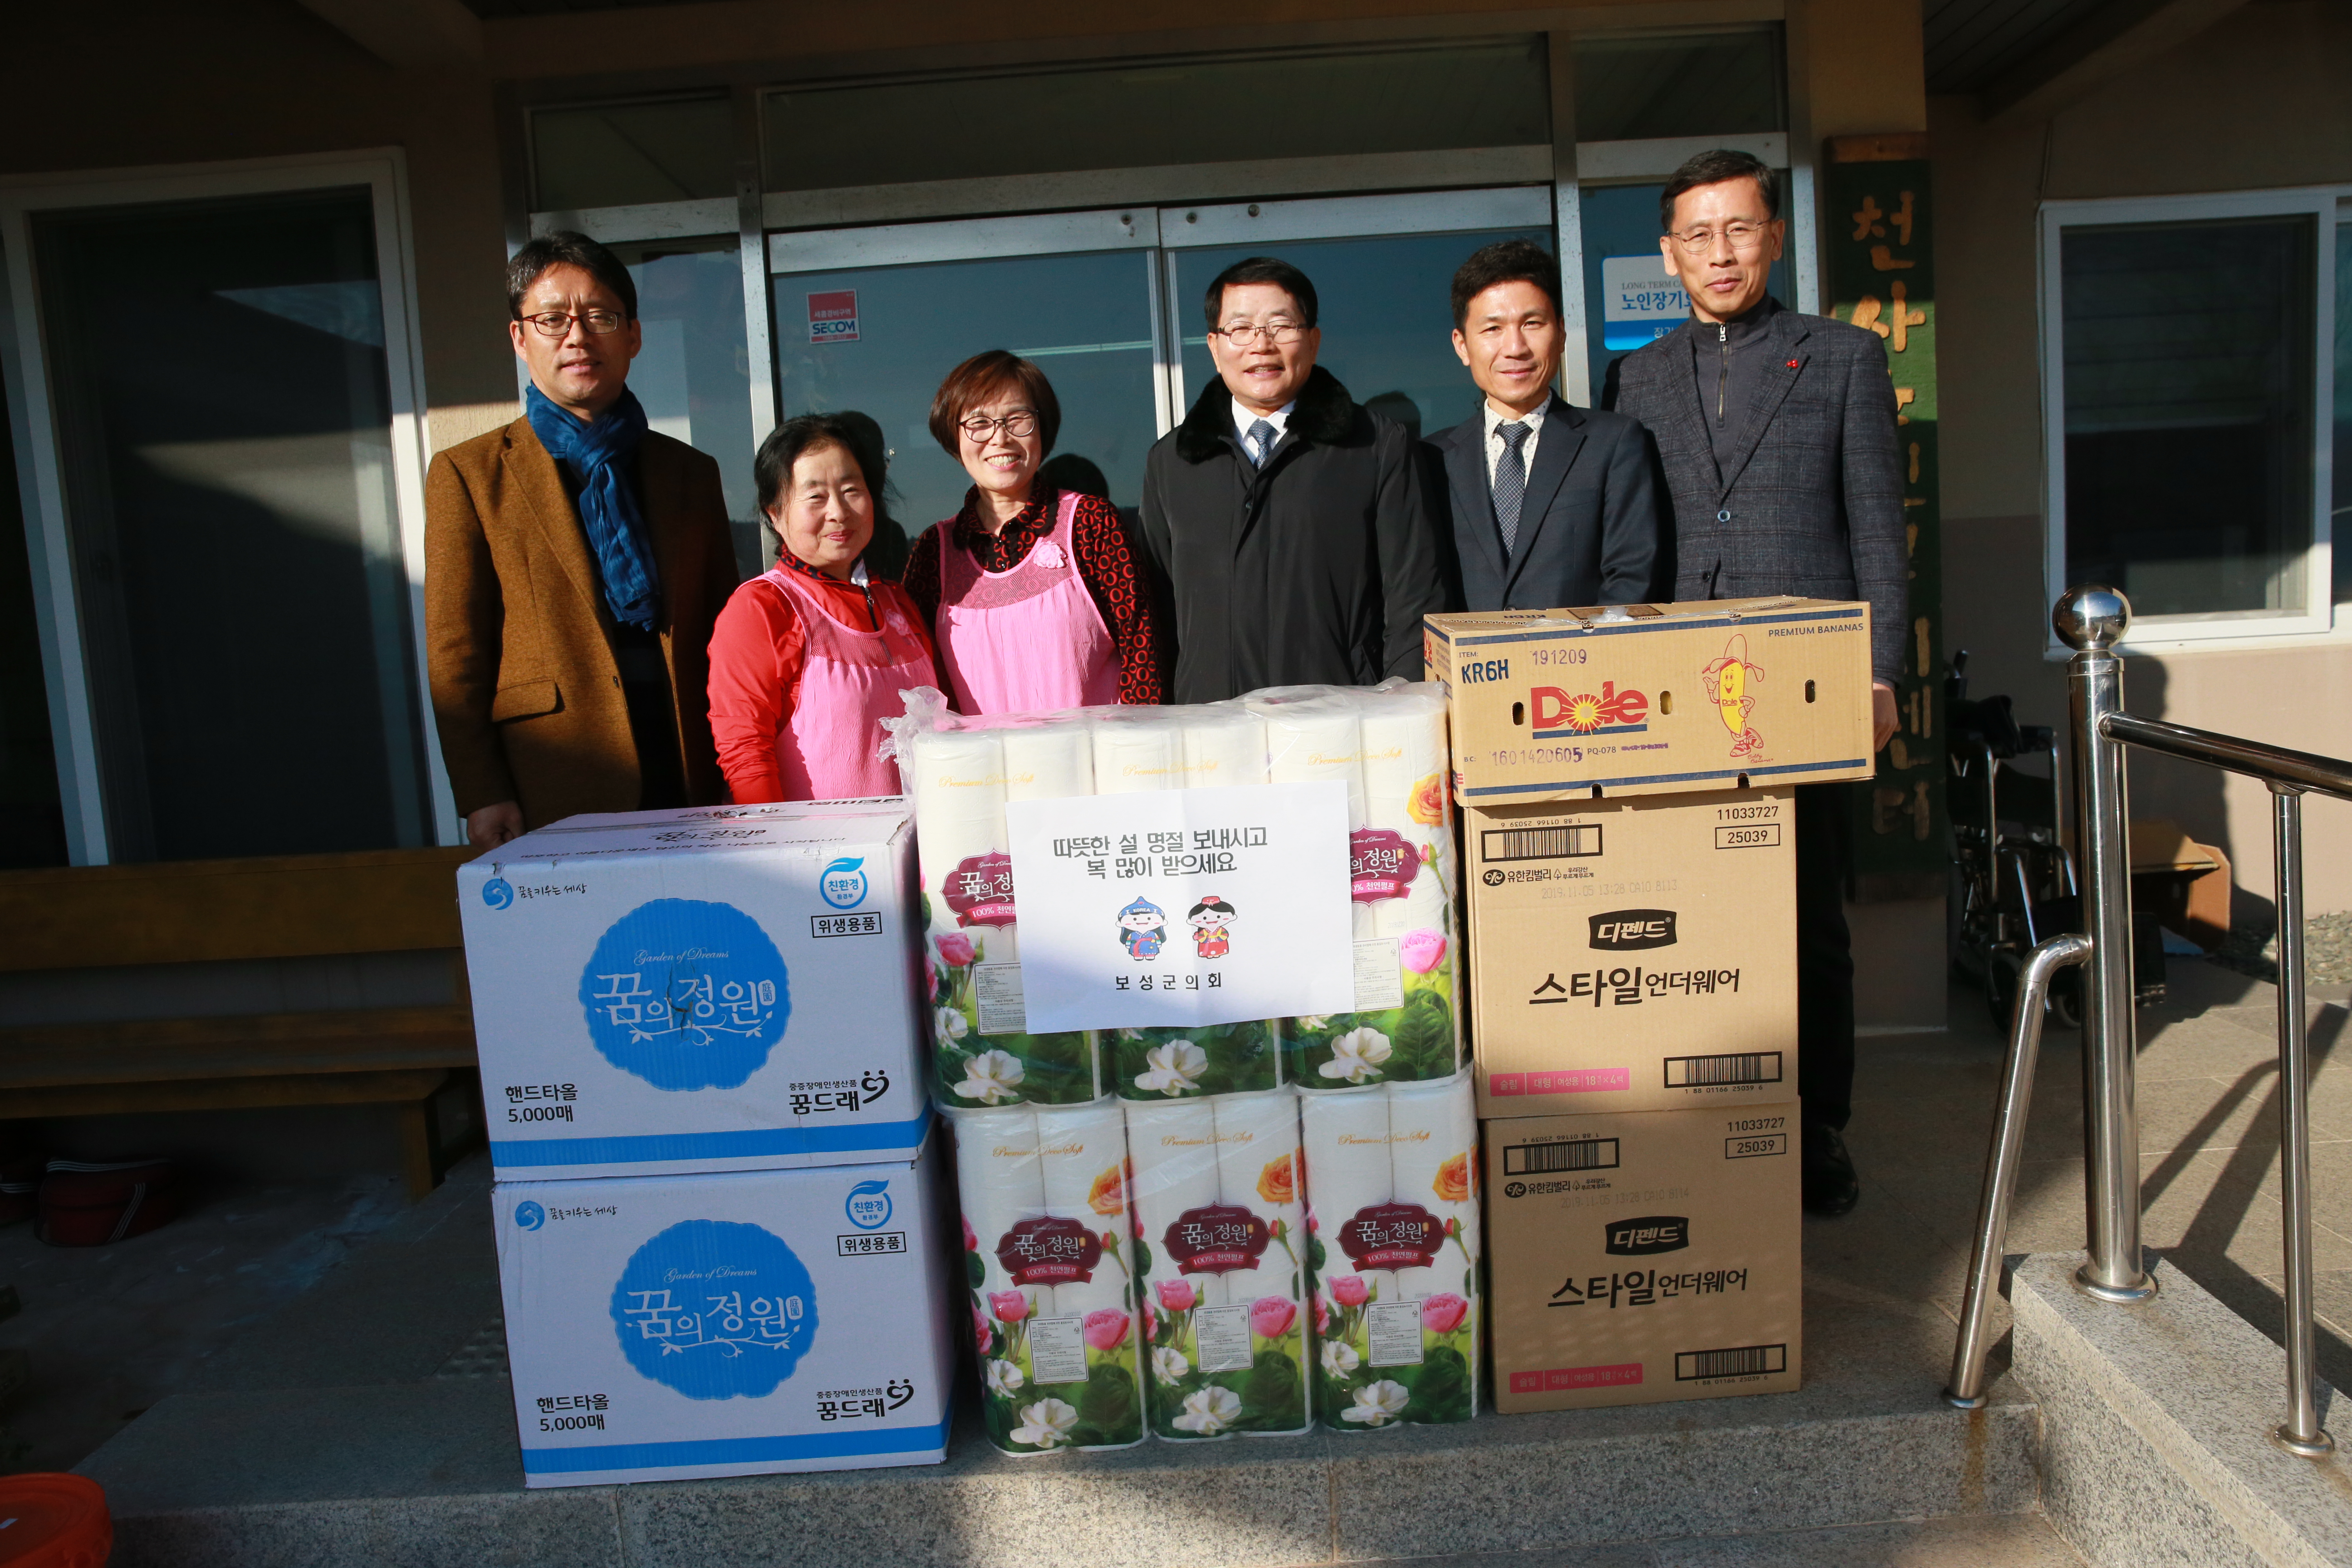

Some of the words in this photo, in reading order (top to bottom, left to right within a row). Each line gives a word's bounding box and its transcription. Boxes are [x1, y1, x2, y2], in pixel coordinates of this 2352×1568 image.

[1622, 282, 1646, 290] LONG
[813, 320, 855, 335] SECOM
[1769, 626, 1815, 637] PREMIUM
[1818, 623, 1863, 634] BANANAS
[1532, 649, 1587, 666] 191209
[1461, 658, 1509, 684] KR6H
[1530, 681, 1649, 732] Dole
[1307, 753, 1352, 766] Premium
[1381, 747, 1402, 762] Soft
[1587, 745, 1617, 755] PQ-078
[1122, 764, 1167, 776] Premium
[1197, 760, 1219, 773] Soft
[938, 776, 983, 788] Premium
[1012, 772, 1034, 787] Soft
[1717, 806, 1779, 821] 11033727
[1053, 836, 1110, 858] 따뜻한
[1118, 833, 1137, 855] 설
[1147, 832, 1184, 853] 명절
[1193, 827, 1268, 850] 보내시고
[1727, 830, 1769, 844] 25039
[1087, 859, 1106, 879] 복
[1115, 857, 1152, 878] 많이
[1161, 852, 1237, 877] 받으세요
[1363, 848, 1397, 868] 정원
[1507, 868, 1552, 883] 유한킴벌리
[828, 878, 859, 892] 친환경
[959, 872, 993, 896] 꿈의
[1366, 882, 1395, 890] 천연펄프
[1542, 885, 1593, 899] 2019.11.05
[1599, 883, 1625, 895] 13:28
[1656, 879, 1677, 891] 8113
[972, 906, 995, 918] 100%
[818, 916, 876, 933] 위생용품
[1598, 920, 1667, 943] 디펜드
[634, 949, 674, 965] Garden
[676, 950, 685, 963] of
[687, 947, 729, 960] Dreams
[593, 972, 674, 1029] 꿈의
[677, 974, 761, 1024] 정원
[789, 1078, 858, 1091] 중증장애인생산품
[1499, 1079, 1517, 1090] 슬림
[1534, 1078, 1551, 1088] 대형
[1558, 1077, 1579, 1086] 여성용
[505, 1083, 578, 1105] 핸드타올
[789, 1092, 860, 1115] 꿈드래
[508, 1107, 574, 1123] 5,000매
[1727, 1117, 1785, 1132] 11033727
[1161, 1135, 1205, 1146] Premium
[1206, 1132, 1231, 1144] Deco
[1233, 1131, 1254, 1145] Soft
[1338, 1134, 1382, 1145] Premium
[1383, 1132, 1408, 1143] Deco
[1409, 1130, 1431, 1144] Soft
[993, 1146, 1035, 1156] Premium
[1037, 1144, 1062, 1156] Deco
[1063, 1142, 1083, 1156] Soft
[1737, 1140, 1775, 1154] 25039
[1528, 1181, 1570, 1194] 유한킴벌리
[1615, 1192, 1639, 1204] 13:28
[1669, 1188, 1689, 1199] 8114
[853, 1199, 884, 1214] 친환경
[1181, 1223, 1213, 1245] 꿈의
[1215, 1223, 1247, 1241] 정원
[1356, 1221, 1388, 1242] 꿈의
[1390, 1220, 1422, 1240] 정원
[1614, 1227, 1680, 1248] 디펜드
[844, 1235, 901, 1252] 위생용품
[1014, 1234, 1045, 1256] 꿈의
[1047, 1235, 1079, 1254] 정원
[1193, 1255, 1215, 1265] 100%
[1367, 1252, 1389, 1262] 100%
[1392, 1251, 1419, 1259] 천연펄프
[664, 1267, 703, 1283] Garden
[705, 1269, 713, 1282] of
[715, 1265, 757, 1279] Dreams
[1026, 1267, 1047, 1277] 100%
[1049, 1265, 1077, 1274] 천연펄프
[623, 1289, 703, 1343] 꿈의
[706, 1290, 789, 1338] 정원
[1519, 1377, 1536, 1387] 슬림
[1552, 1375, 1568, 1384] 대형
[1574, 1373, 1594, 1382] 여성용
[817, 1387, 883, 1399] 중증장애인생산품
[537, 1393, 610, 1414] 핸드타올
[816, 1400, 886, 1422] 꿈드래
[539, 1416, 605, 1432] 5,000매
